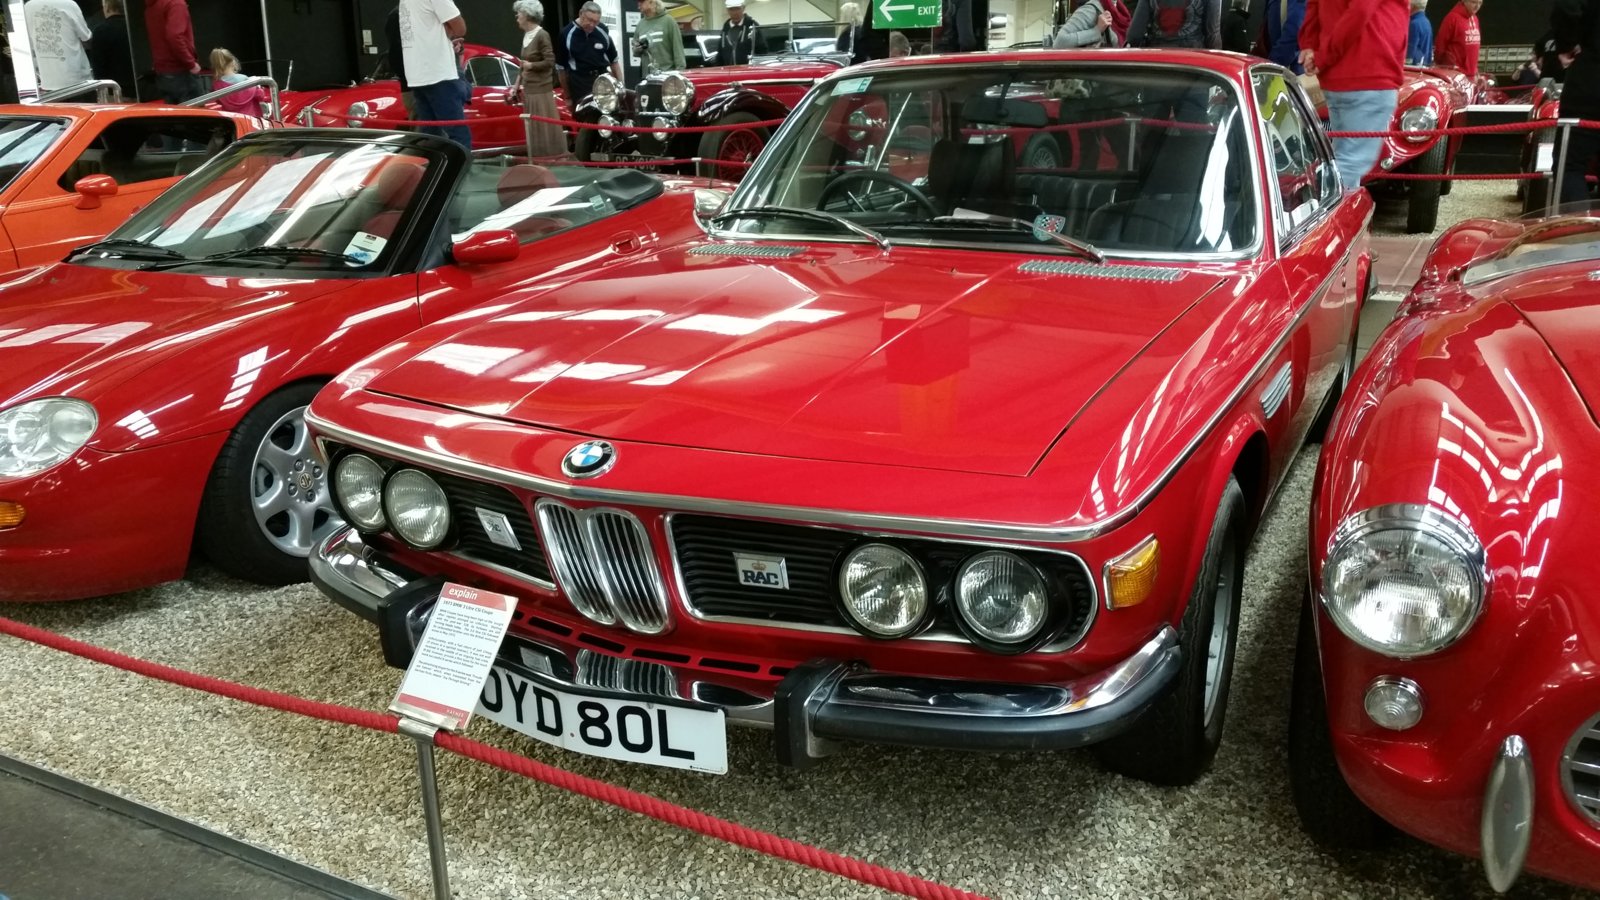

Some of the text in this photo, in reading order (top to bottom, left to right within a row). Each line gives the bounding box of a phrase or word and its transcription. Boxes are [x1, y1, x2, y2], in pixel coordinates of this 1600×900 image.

[917, 6, 936, 16] EXIT
[742, 569, 779, 586] RAC
[448, 587, 478, 600] explain
[480, 668, 695, 761] OYD 80L
